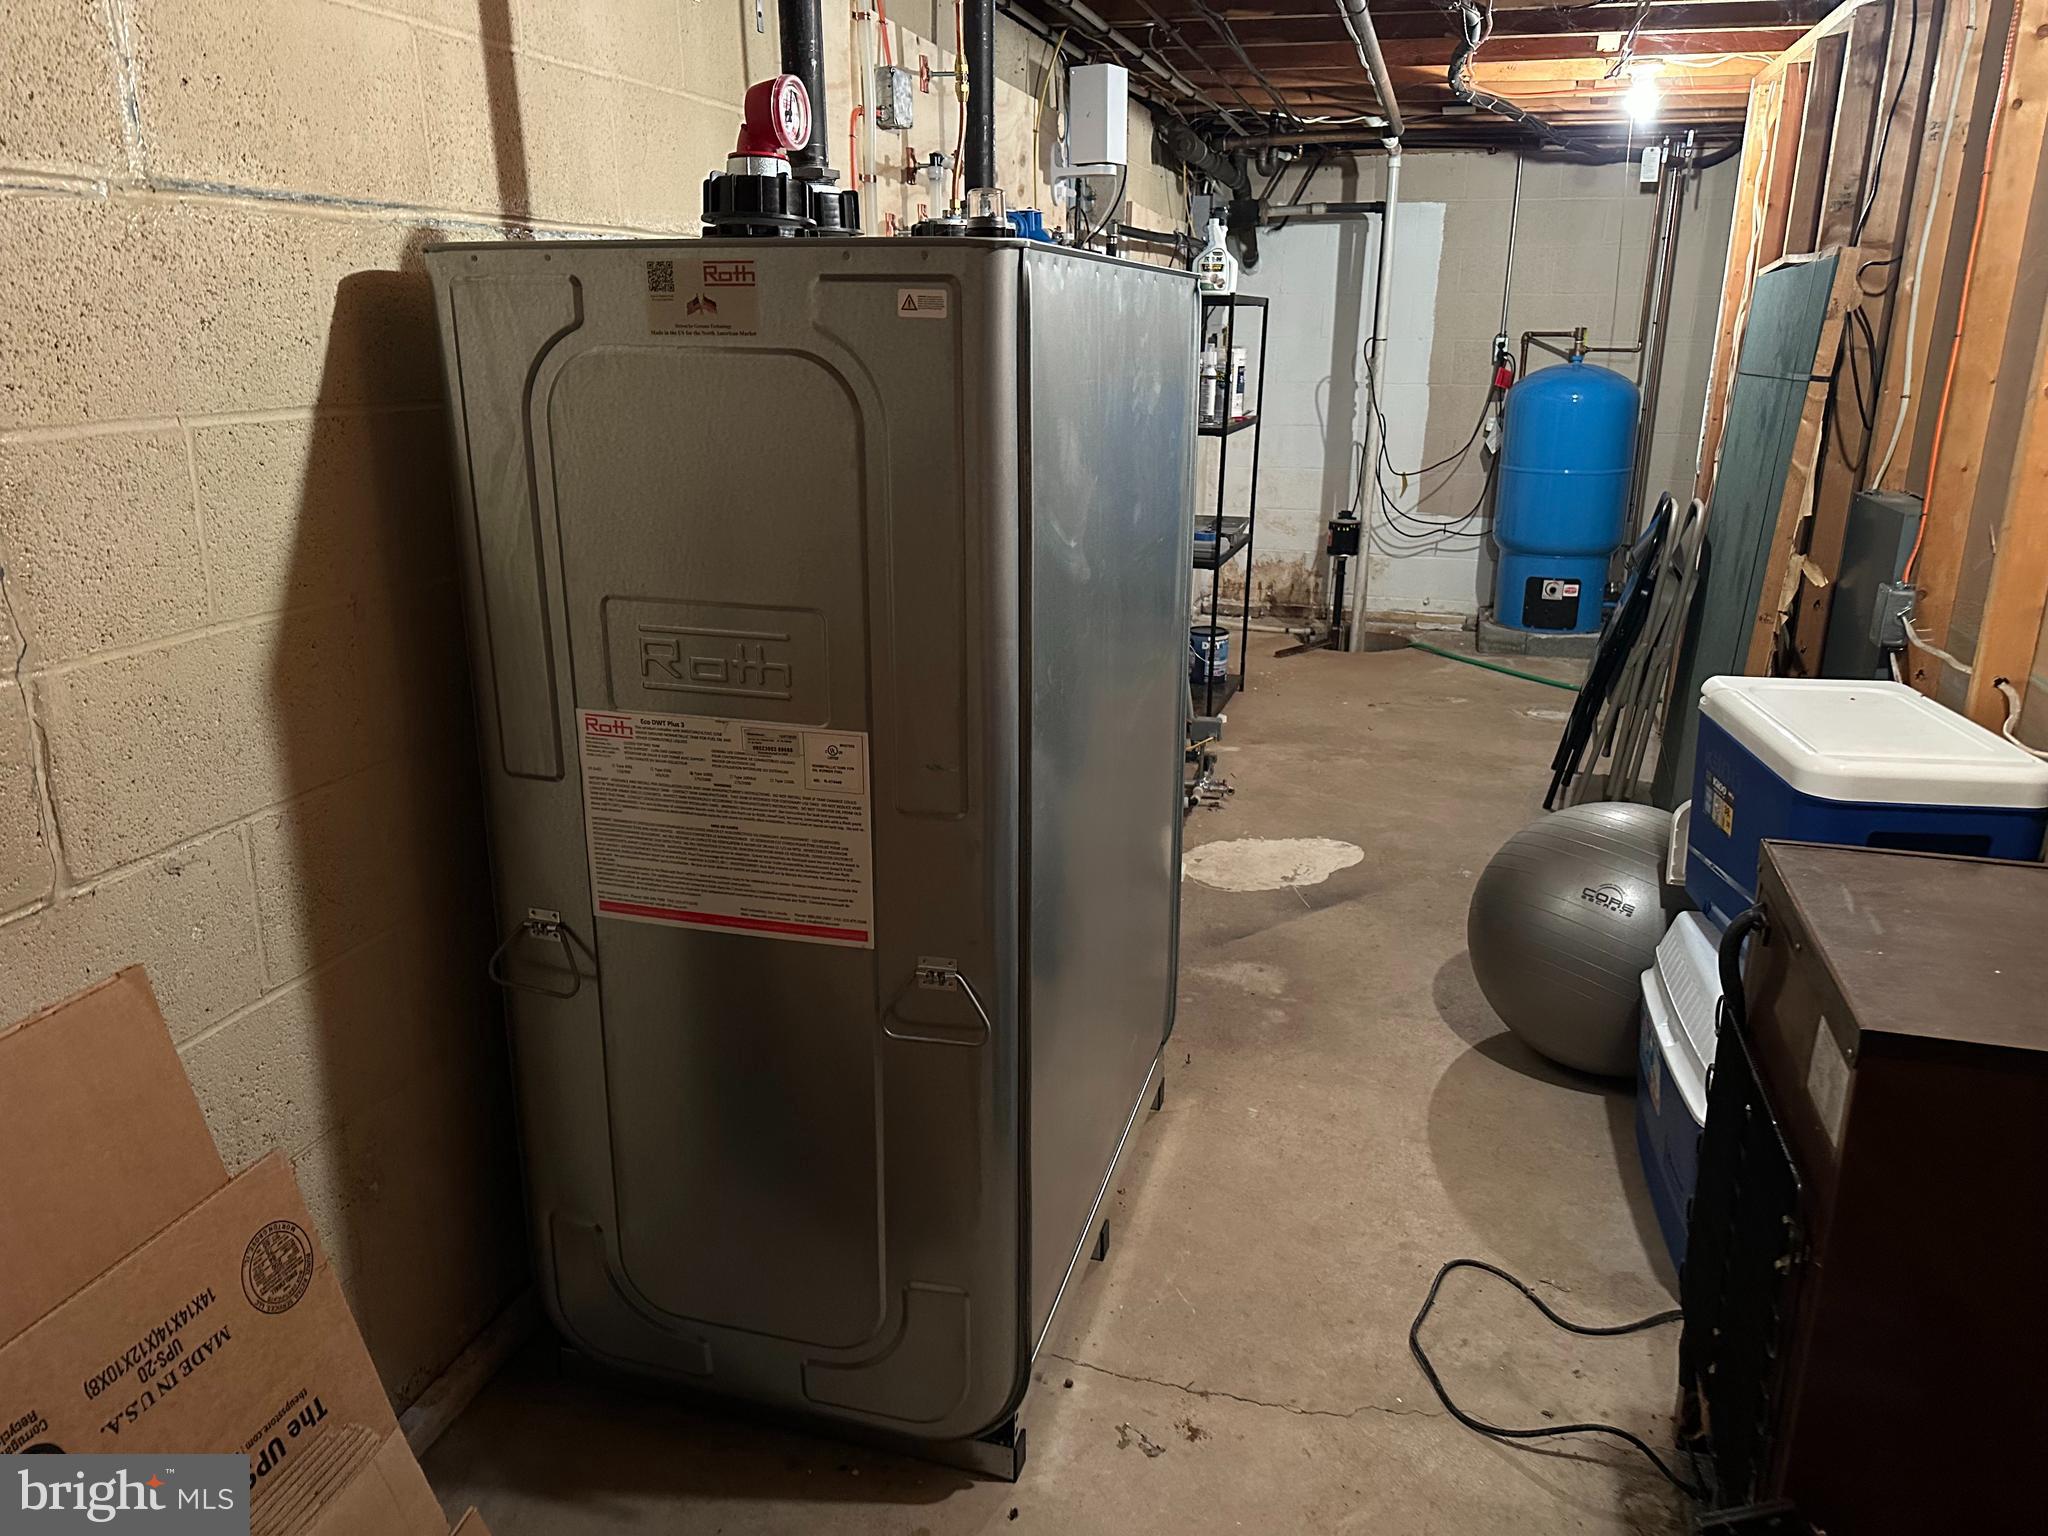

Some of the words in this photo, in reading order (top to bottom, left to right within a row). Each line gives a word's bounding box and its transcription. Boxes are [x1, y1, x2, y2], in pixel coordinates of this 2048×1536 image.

[703, 265, 755, 282] Roth
[639, 636, 792, 688] Roth
[585, 717, 633, 735] Roth
[1582, 887, 1636, 914] CORE
[84, 1288, 216, 1400] 14X14X14(X12X10X8)
[137, 1338, 184, 1383] UPS-20
[178, 1325, 232, 1377] MADE
[155, 1370, 179, 1397] IN
[0, 1410, 38, 1446] Recycl
[0, 1418, 48, 1454] Corruga
[245, 1388, 308, 1450] theupsstore.com
[287, 1396, 328, 1438] The
